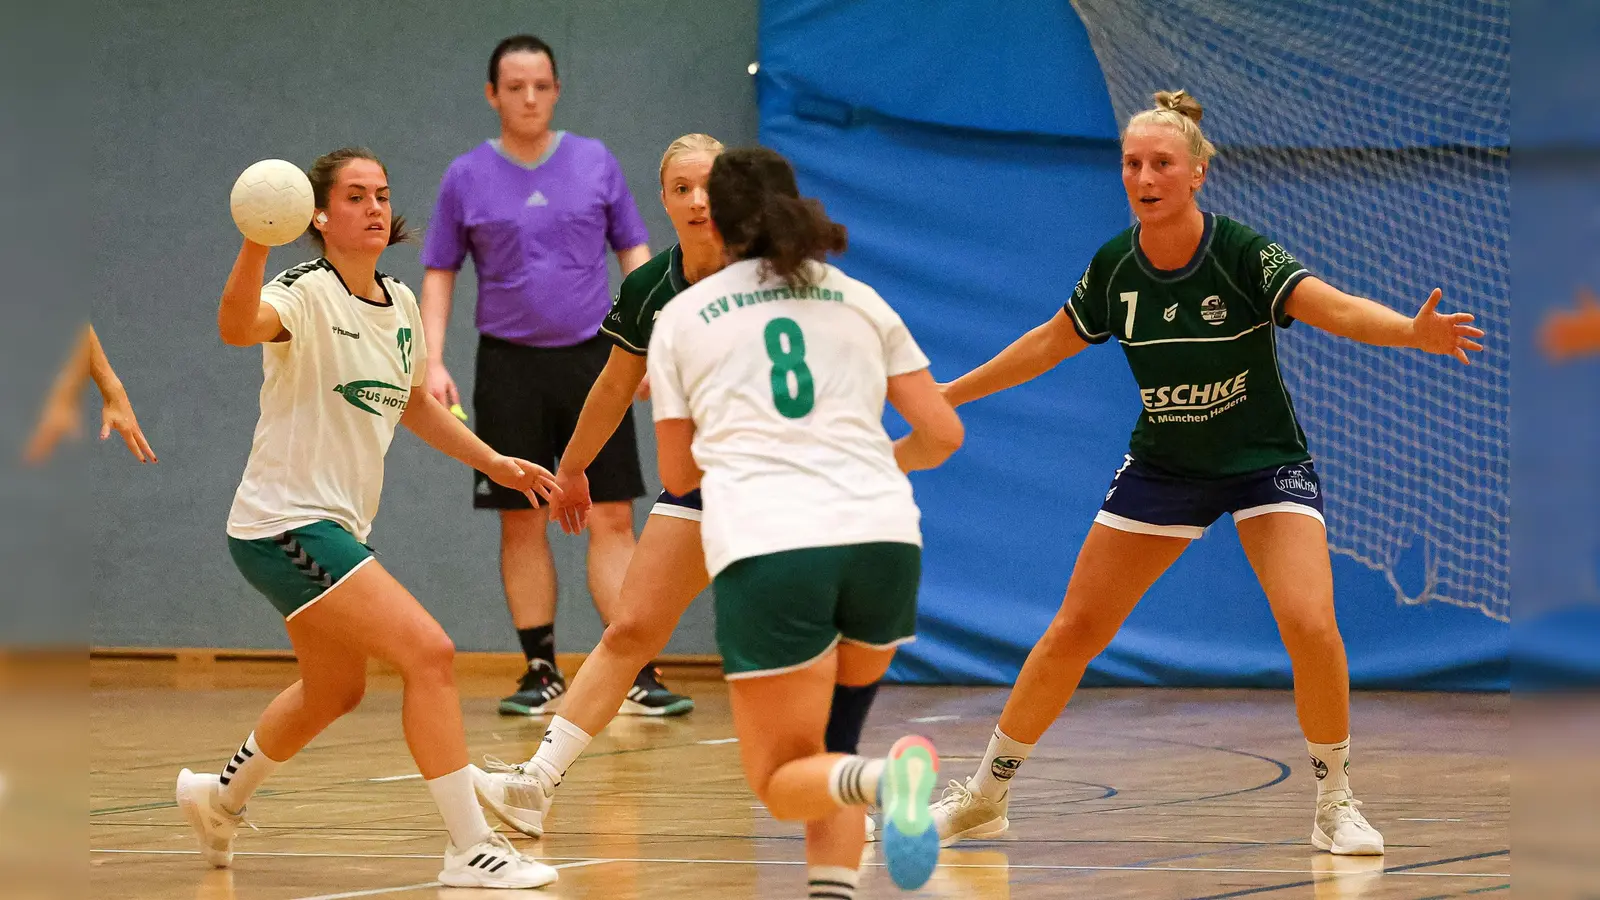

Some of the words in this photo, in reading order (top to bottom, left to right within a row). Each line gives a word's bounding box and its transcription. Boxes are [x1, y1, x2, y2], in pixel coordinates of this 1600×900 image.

[698, 296, 730, 324] TSV
[1119, 291, 1139, 339] 7
[763, 317, 816, 419] 8
[1158, 413, 1209, 424] München
[1210, 394, 1247, 418] Hadern
